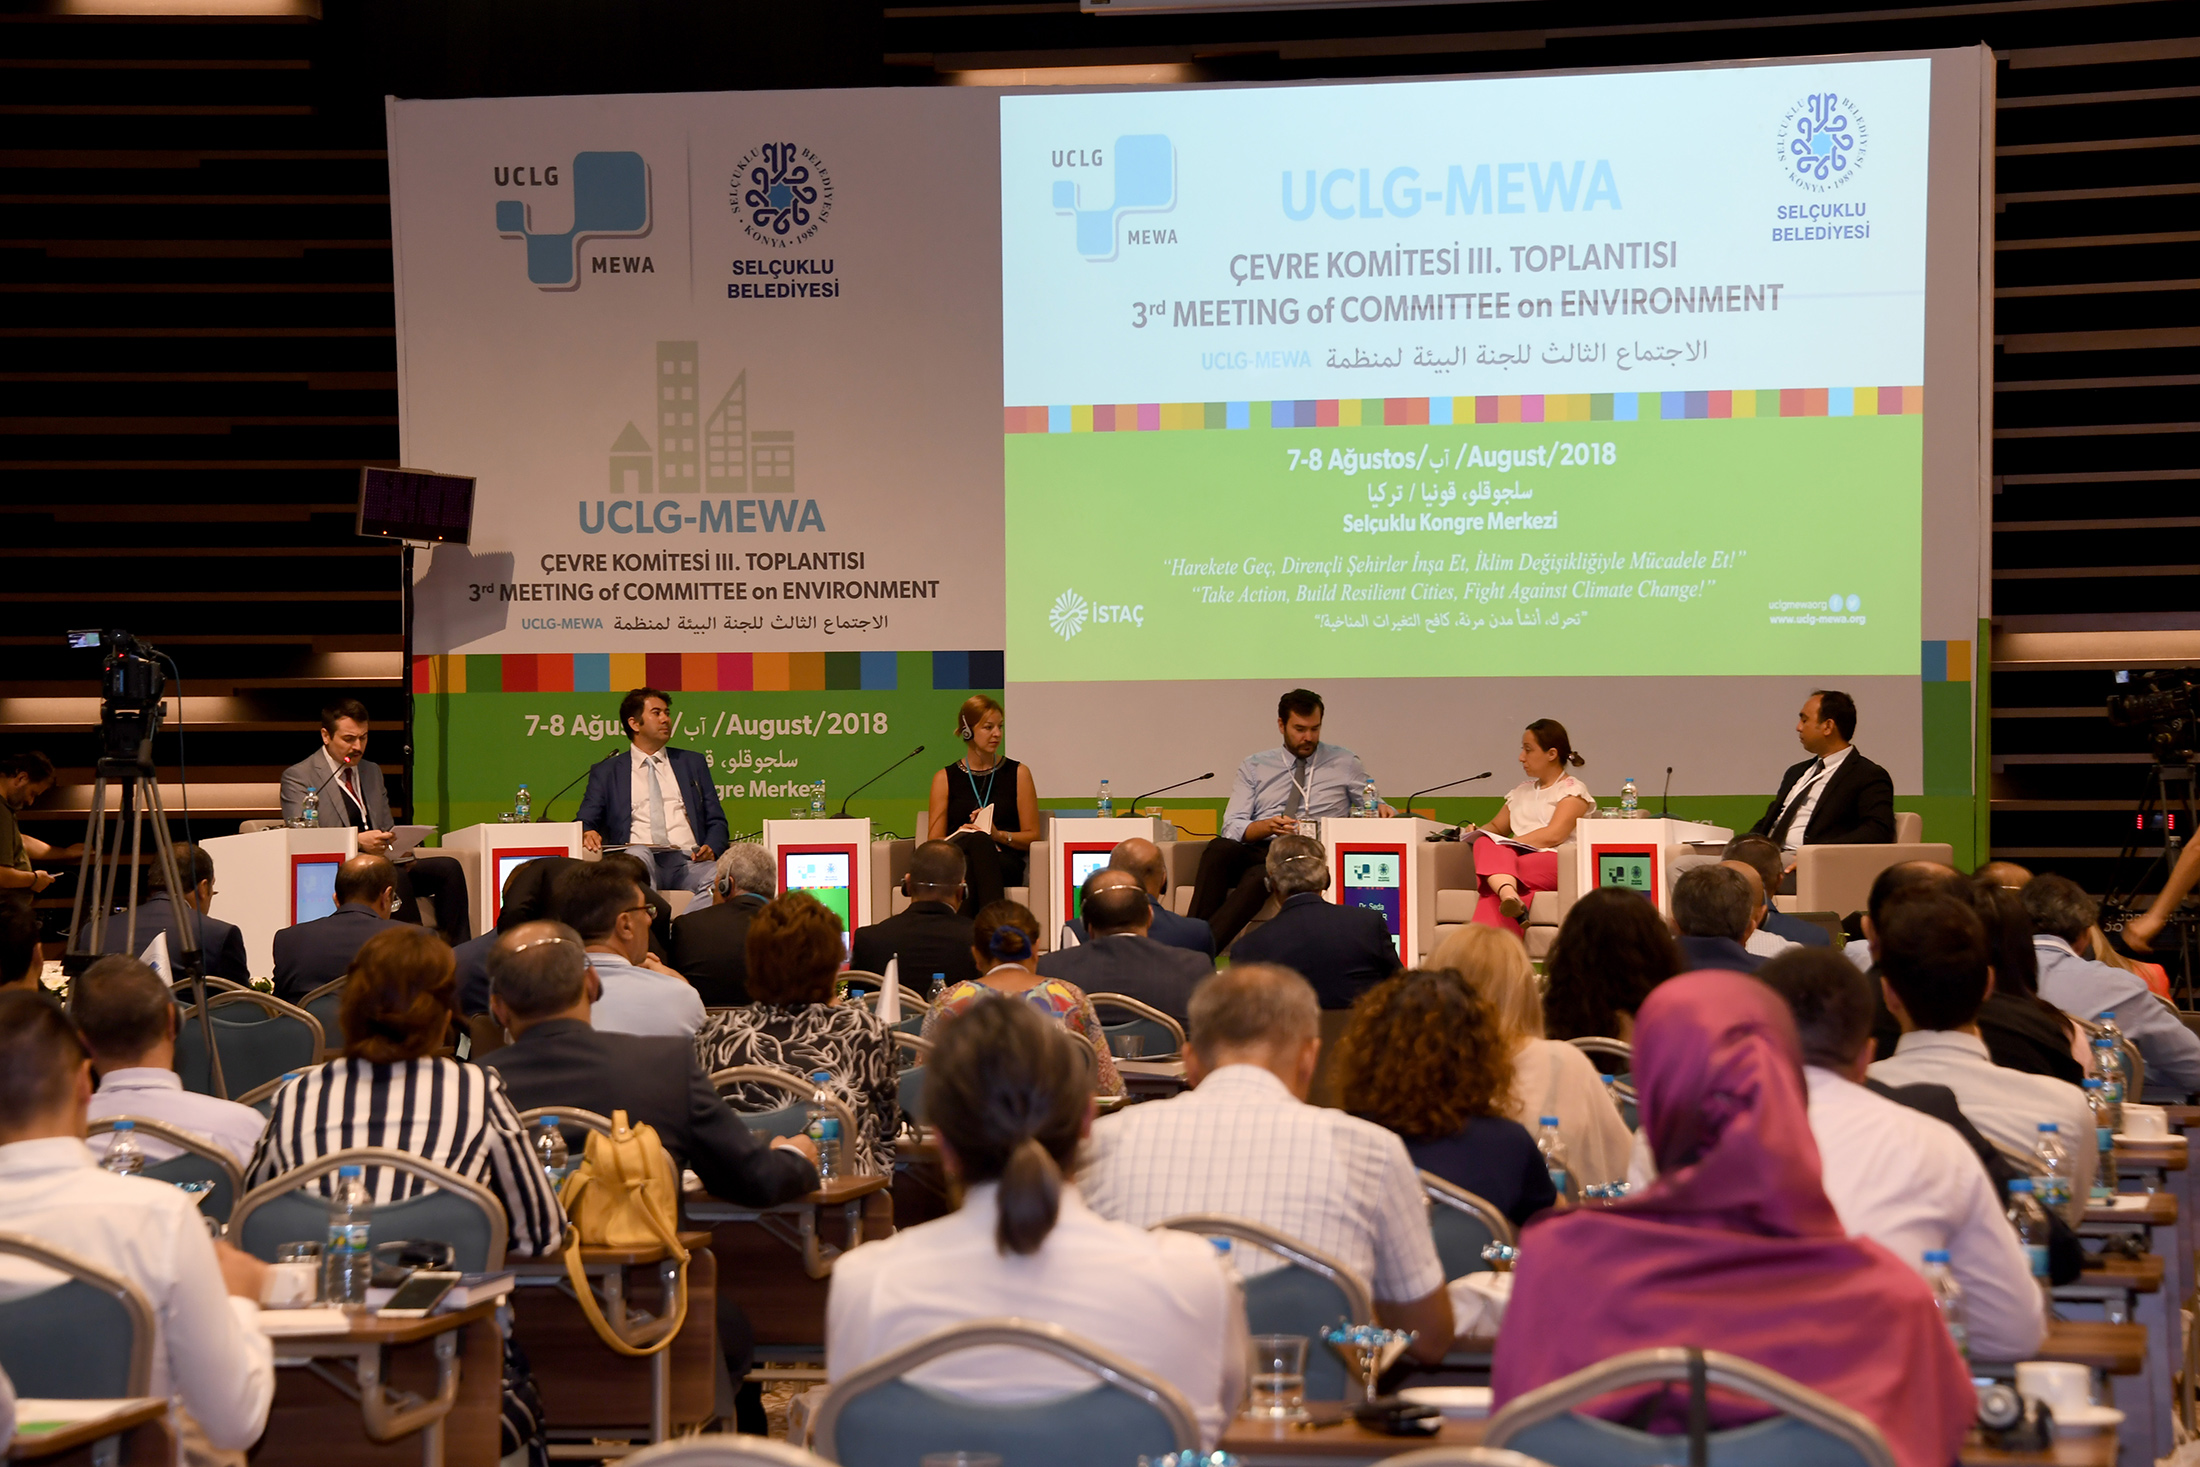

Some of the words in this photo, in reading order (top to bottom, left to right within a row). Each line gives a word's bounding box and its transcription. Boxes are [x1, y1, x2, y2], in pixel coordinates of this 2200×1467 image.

[1777, 99, 1805, 161] SELÇUKLU
[1842, 97, 1869, 168] BELEDİYESİ
[1051, 150, 1103, 168] UCLG
[494, 167, 559, 186] UCLG
[729, 147, 759, 214] SELÇUKLU
[802, 148, 834, 224] BELEDİYESİ
[1789, 172, 1825, 193] KONYA
[1834, 169, 1854, 189] 1989
[1282, 159, 1621, 221] UCLG-MEWA
[1777, 202, 1866, 222] SELÇUKLU
[744, 225, 786, 248] KONYA
[796, 225, 818, 243] 1989
[1127, 229, 1178, 245] MEWA
[1772, 221, 1869, 241] BELEDİYESİ
[592, 256, 655, 273] MEWA
[733, 259, 834, 279] SELÇUKLU
[1229, 251, 1319, 286] ÇEVRE
[1328, 241, 1460, 279] KOMİTESİ
[1468, 246, 1501, 274] III.
[1510, 241, 1677, 273] TOPLANTISI
[728, 279, 839, 298] BELEDİYESİ
[1173, 297, 1299, 327] MEETING
[1306, 296, 1335, 324] of
[1340, 292, 1510, 324] COMMITTEE
[1517, 296, 1553, 318] on
[1561, 284, 1784, 317] ENVIRONMENT
[1201, 349, 1312, 371] UCLG-MEWA
[1326, 348, 1401, 369] لمنظمة
[1413, 346, 1466, 374] البيئة
[1476, 344, 1531, 371] للجنة
[1541, 342, 1605, 365] الثالث
[1616, 340, 1707, 371] الاجتماع
[1287, 448, 1323, 472] 7-8
[1368, 481, 1403, 507] تركيا
[1421, 481, 1457, 506] قونيا
[579, 500, 826, 534] UCLG-MEWA
[1343, 514, 1415, 536] Selçuklu
[1420, 513, 1483, 536] Kongre
[1488, 510, 1557, 532] Merkezi
[540, 553, 608, 575] ÇEVRE
[613, 549, 709, 571] KOMİTESİ
[716, 553, 740, 571] III.
[745, 552, 864, 570] TOPLANTISI
[1243, 557, 1275, 577] Geç,
[1281, 556, 1342, 577] Dirençli
[1346, 554, 1408, 576] Şehirler
[1412, 551, 1445, 574] İnşa
[1448, 553, 1470, 572] Et,
[1474, 549, 1513, 571] İklim
[1518, 552, 1625, 575] Değişikliğiyle
[1629, 551, 1706, 570] Mücadele
[500, 583, 593, 601] MEETING
[599, 583, 620, 600] of
[623, 582, 747, 601] COMMITTEE
[752, 585, 778, 599] on
[783, 580, 940, 600] ENVIRONMENT
[1238, 584, 1290, 603] Action,
[1295, 585, 1336, 602] Build
[1341, 583, 1406, 602] Resilient
[1410, 582, 1458, 602] Cities,
[1463, 582, 1504, 603] Fight
[1508, 581, 1567, 600] Against
[1572, 580, 1633, 598] Climate
[522, 618, 603, 630] UCLG-MEWA
[614, 616, 670, 631] لمنظمة
[770, 614, 817, 631] الثالث
[823, 614, 888, 634] الاجتماع
[1093, 600, 1144, 628] İSTAÇ
[1373, 613, 1420, 631] التغيرات
[1425, 613, 1450, 633] كافح
[1454, 613, 1485, 630] مرنة،
[1489, 613, 1513, 630] مدن
[1516, 608, 1541, 626] أنشأ
[1770, 613, 1866, 625] www.uclg-mewa.org
[677, 616, 717, 634] البيئة
[724, 616, 764, 634] للجنة
[524, 715, 564, 736] 7-8
